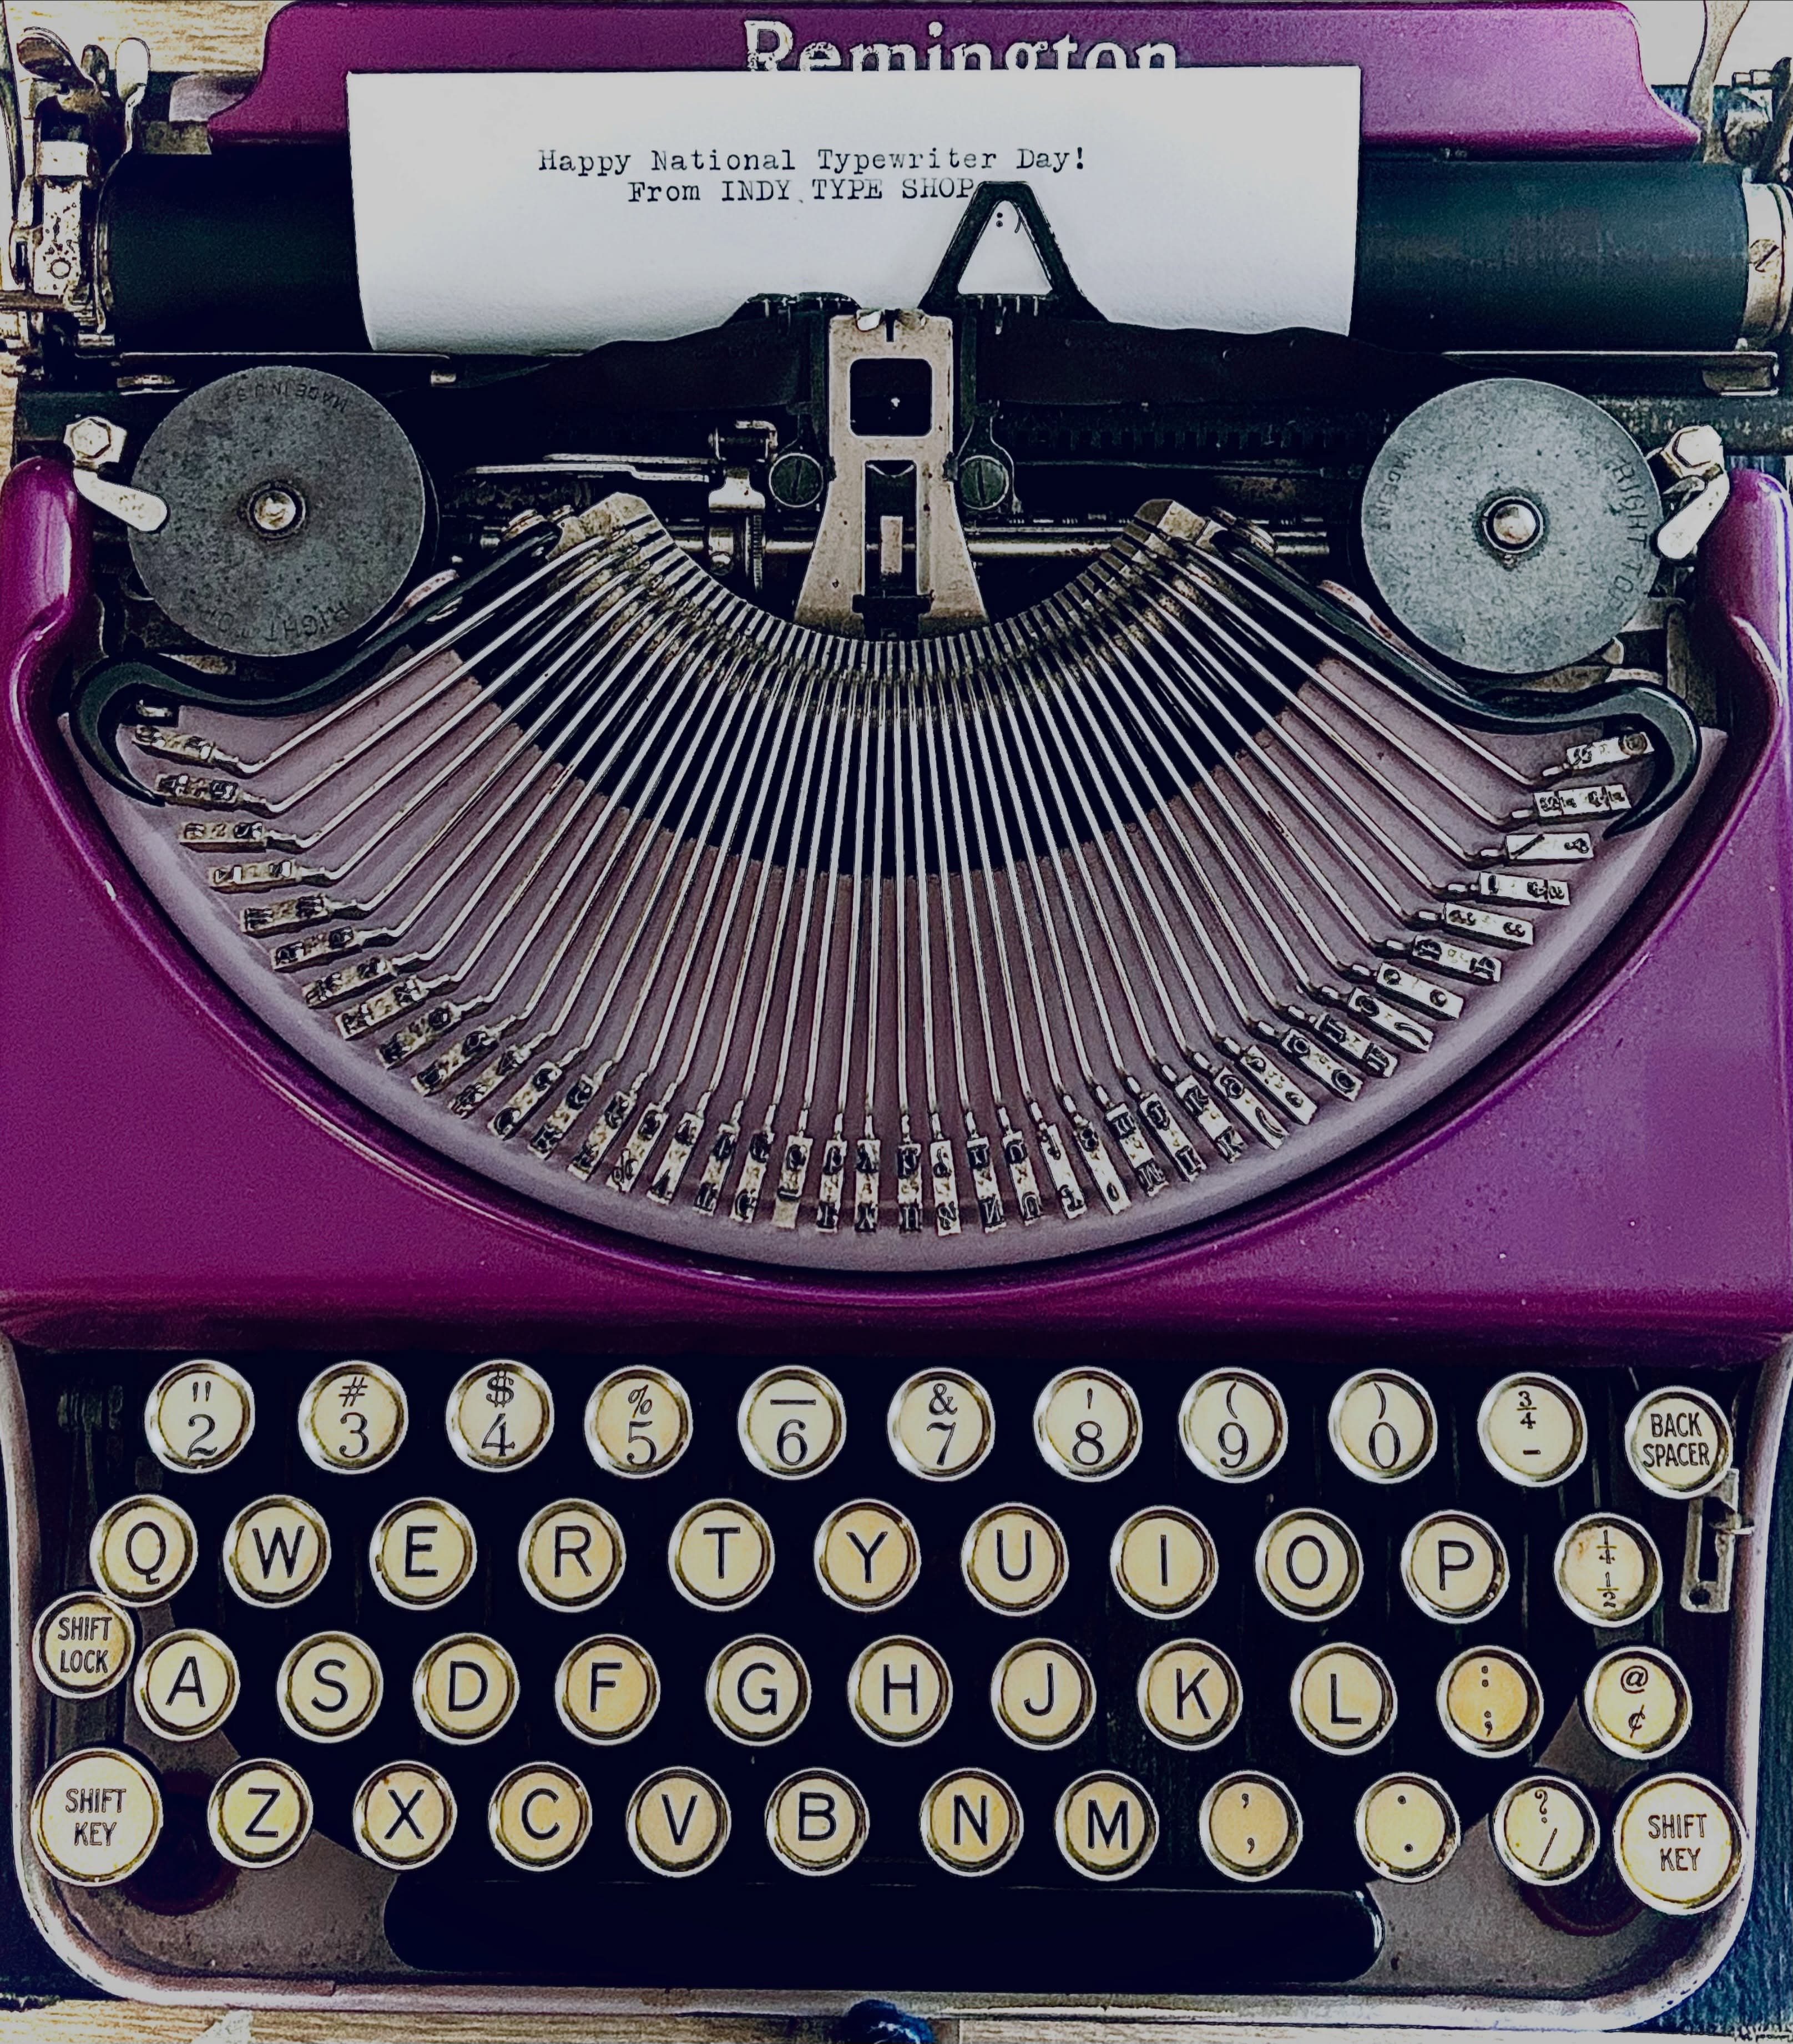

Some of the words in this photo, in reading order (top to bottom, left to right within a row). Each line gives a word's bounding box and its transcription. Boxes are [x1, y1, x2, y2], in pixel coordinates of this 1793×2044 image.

[744, 20, 1176, 70] Remington
[538, 149, 631, 176] Happy
[651, 149, 795, 171] National
[818, 147, 997, 174] Typewriter
[1017, 147, 1084, 173] Day!
[628, 181, 701, 202] From
[812, 178, 882, 199] TYPE
[902, 178, 974, 199] SHOP
[1611, 458, 1648, 549] RIGHT
[263, 601, 351, 643] RIGHT
[339, 1376, 368, 1407] #
[486, 1371, 514, 1407] $
[628, 1385, 652, 1418] %
[929, 1383, 957, 1415] &
[1226, 1382, 1238, 1419] (
[1374, 1383, 1386, 1419] )
[188, 1414, 217, 1458] 2
[339, 1412, 368, 1458] 3
[482, 1414, 515, 1457] 4
[627, 1421, 656, 1465] 5
[777, 1420, 807, 1466] 6
[927, 1422, 956, 1466] 7
[1072, 1421, 1104, 1466] 8
[1218, 1422, 1248, 1468] 9
[1651, 1412, 1702, 1437] BACK
[1642, 1442, 1710, 1467] SPACER
[125, 1522, 166, 1585] Q
[252, 1526, 305, 1579] W
[405, 1526, 438, 1577] E
[555, 1525, 592, 1577] R
[703, 1527, 740, 1579] T
[846, 1532, 888, 1583] Y
[997, 1530, 1032, 1581] U
[1161, 1535, 1168, 1586] I
[1286, 1535, 1328, 1590] O
[1438, 1540, 1474, 1591] P
[58, 1617, 112, 1641] SHIFT
[60, 1650, 108, 1673] LOCK
[166, 1656, 205, 1707] A
[1482, 1666, 1488, 1687] :
[1620, 1666, 1648, 1694] @
[311, 1659, 348, 1713] S
[448, 1661, 488, 1712] D
[590, 1663, 622, 1712] F
[738, 1663, 777, 1715] G
[883, 1664, 917, 1715] H
[1024, 1663, 1054, 1716] J
[1176, 1668, 1211, 1720] K
[1331, 1674, 1361, 1724] L
[1484, 1710, 1492, 1737] ;
[65, 1789, 126, 1813] SHIFT
[245, 1788, 280, 1838] Z
[385, 1789, 424, 1839] X
[522, 1788, 559, 1840] C
[661, 1794, 698, 1845] V
[798, 1791, 836, 1841] B
[954, 1795, 987, 1846] N
[1534, 1789, 1548, 1824] ?
[74, 1822, 117, 1846] KEY
[1088, 1800, 1128, 1850] M
[1648, 1814, 1707, 1839] SHIFT
[1660, 1848, 1700, 1871] KEY
